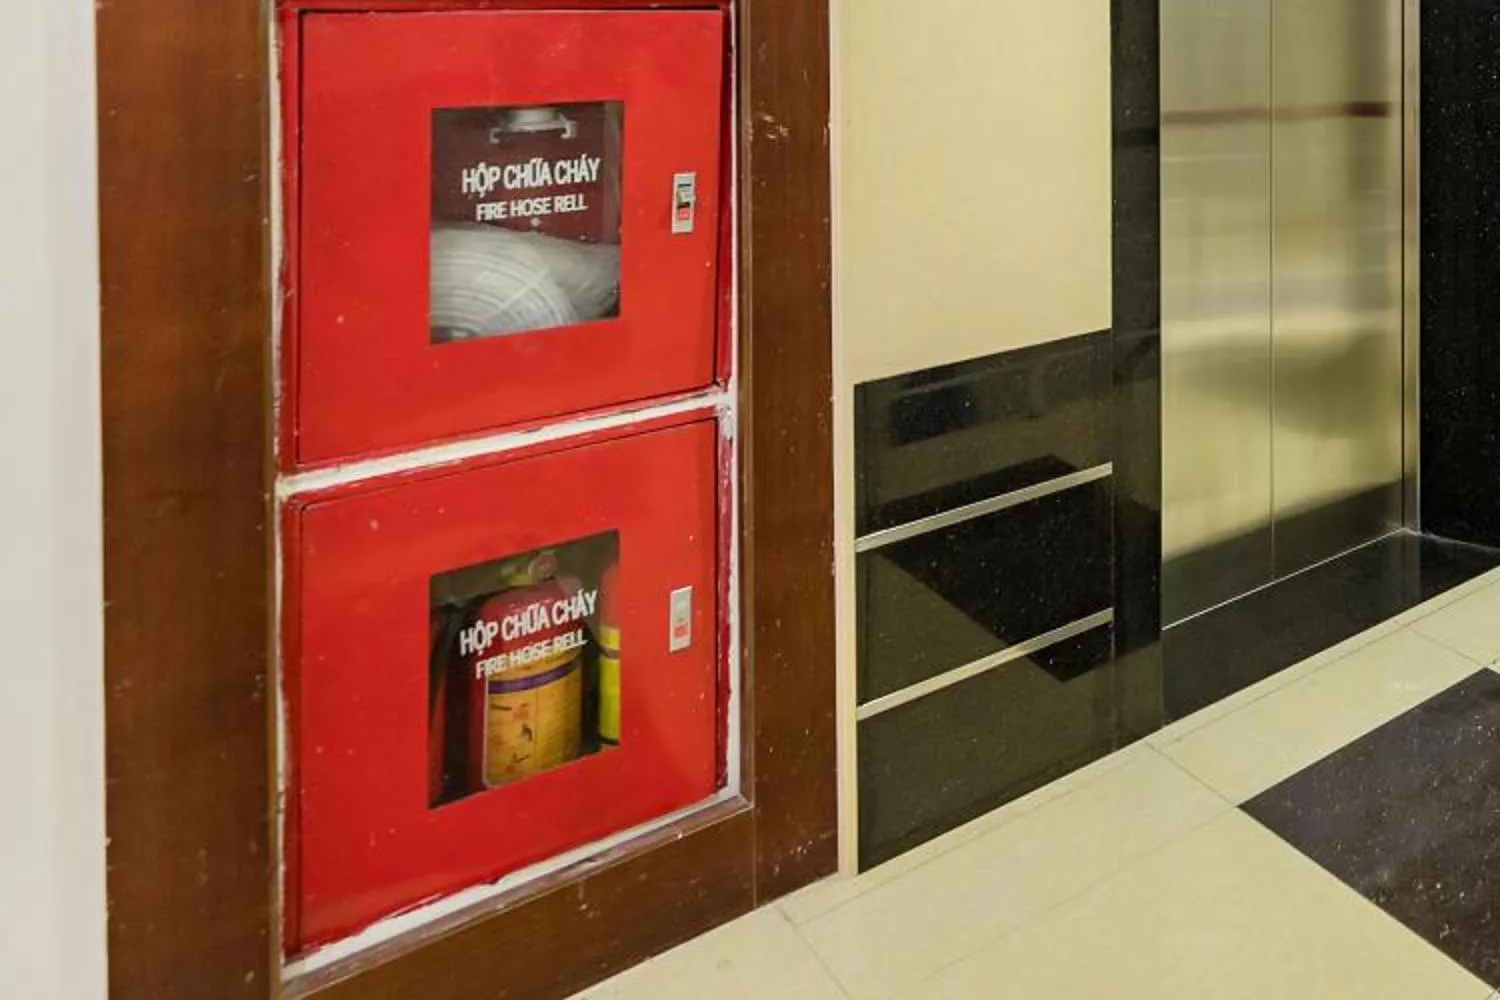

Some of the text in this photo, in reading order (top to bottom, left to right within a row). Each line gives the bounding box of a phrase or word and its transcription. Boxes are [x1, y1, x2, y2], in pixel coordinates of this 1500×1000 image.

[461, 153, 601, 198] HỘP CHỮA CHÁY
[476, 193, 588, 221] FIRE HOSE RELL
[459, 588, 598, 656] HỘP CHỮA CHÁY
[475, 628, 588, 679] FIRE HOSE RELL
